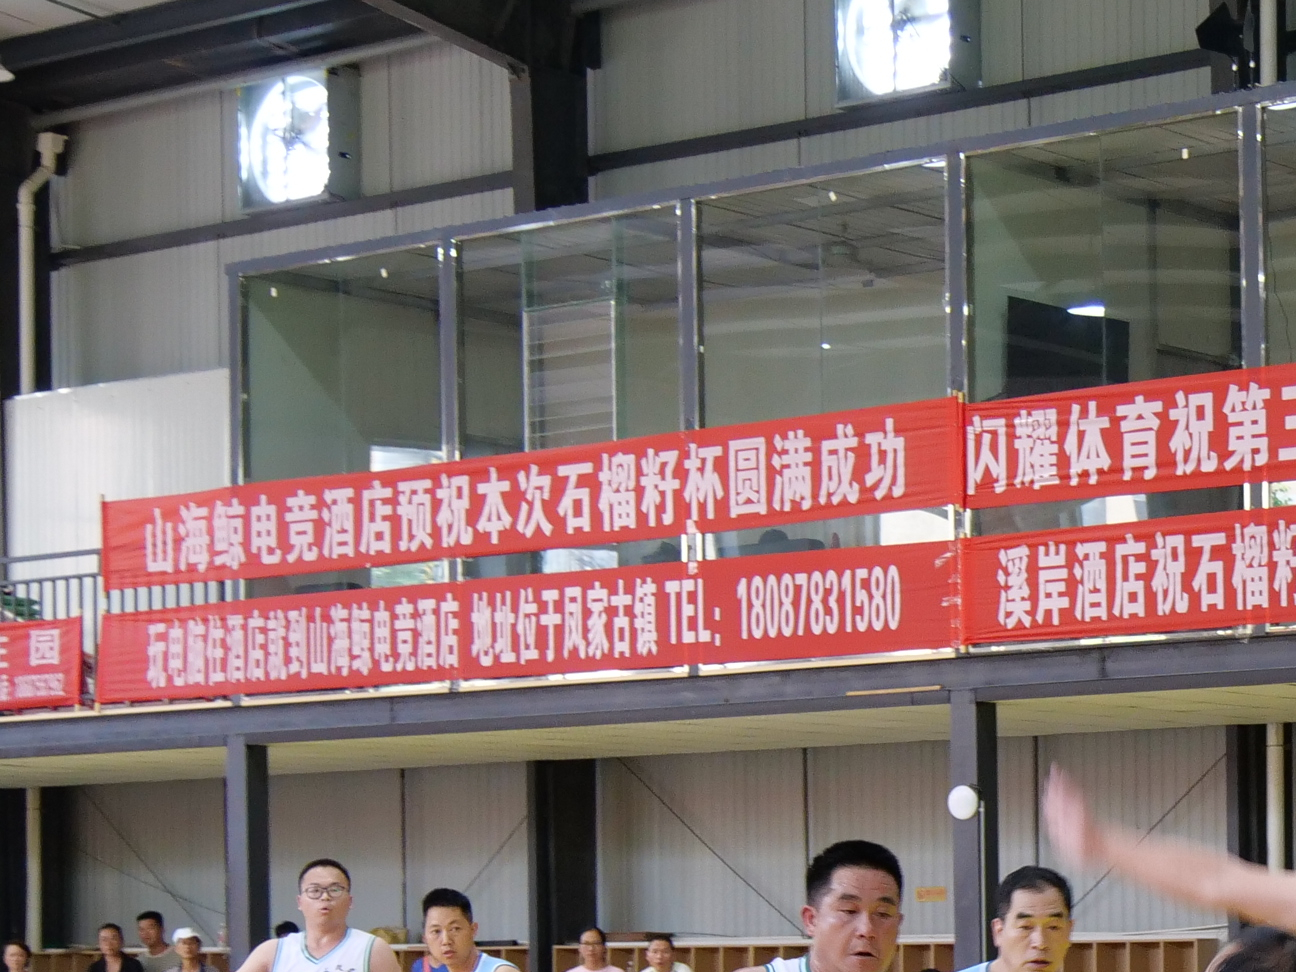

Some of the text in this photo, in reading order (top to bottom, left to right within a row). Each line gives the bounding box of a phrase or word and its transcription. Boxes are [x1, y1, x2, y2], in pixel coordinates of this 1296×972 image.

[144, 417, 906, 573] 山海鲸电竞酒店预祝本次石榴籽杯圆满成功
[736, 564, 901, 641] 18087831580
